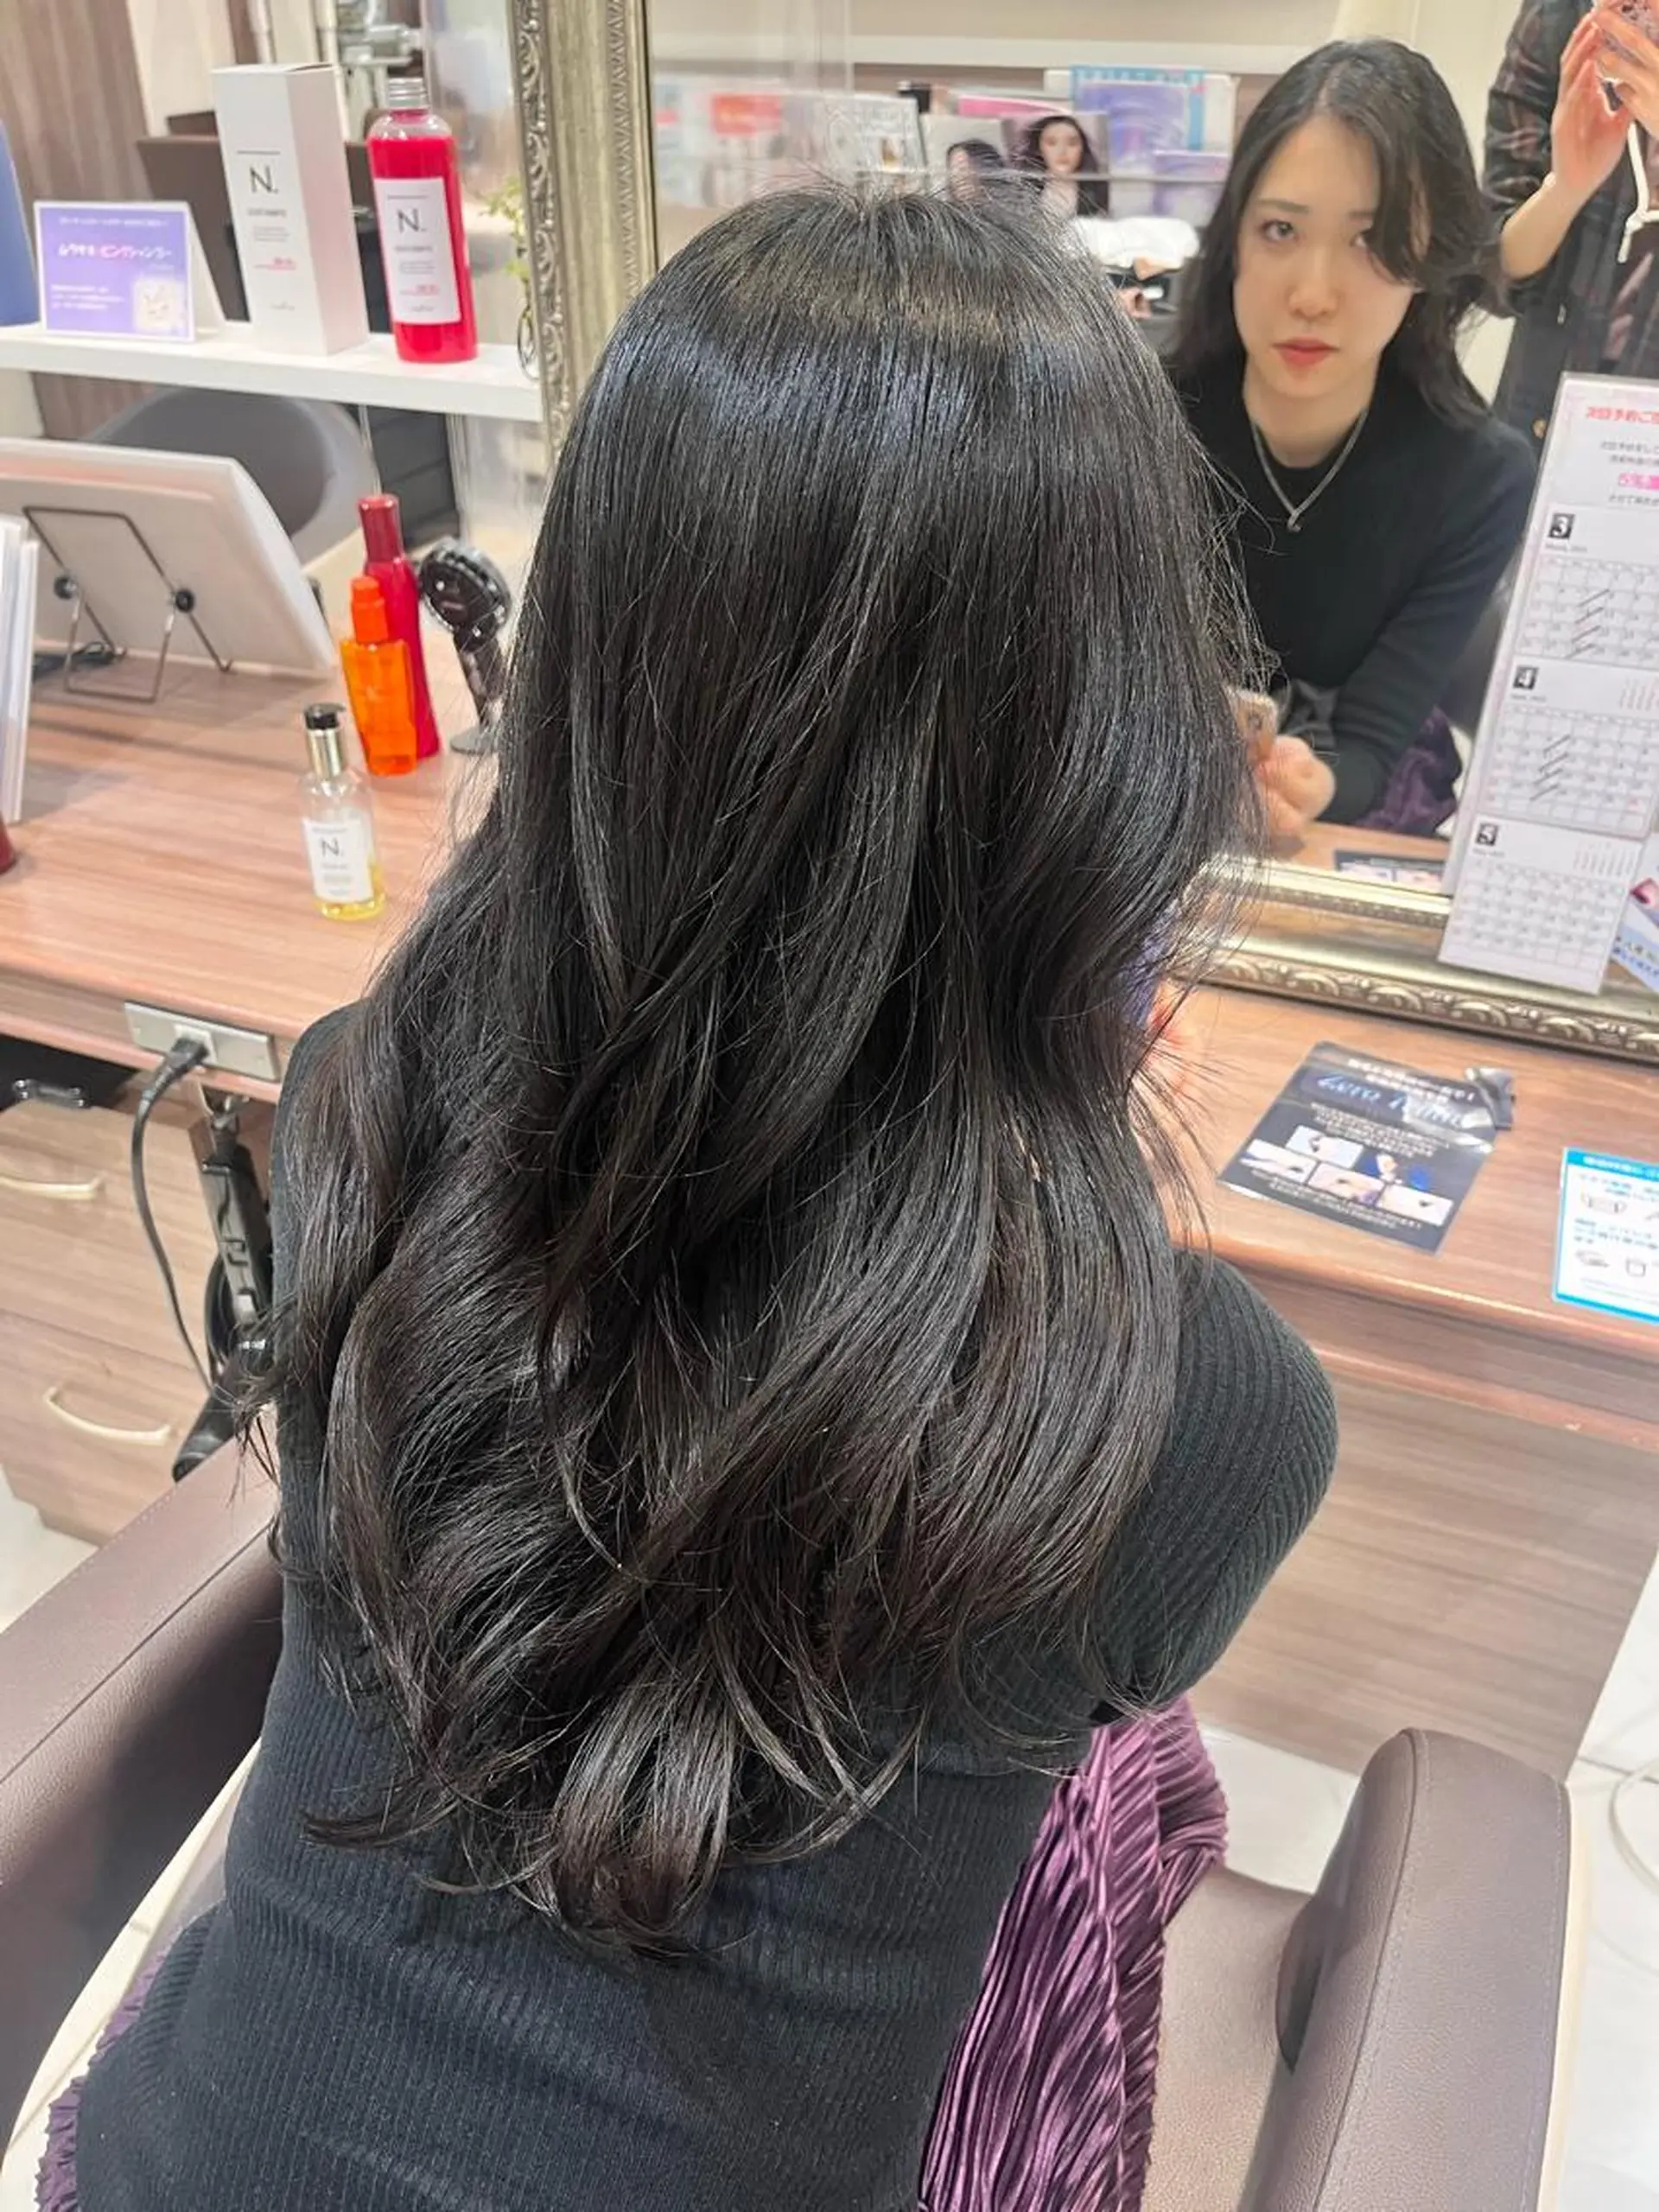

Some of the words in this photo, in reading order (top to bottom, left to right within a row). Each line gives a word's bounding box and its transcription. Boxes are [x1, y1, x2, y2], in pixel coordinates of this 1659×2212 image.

[250, 165, 279, 194] N.
[397, 208, 427, 233] N.
[321, 836, 344, 857] N.
